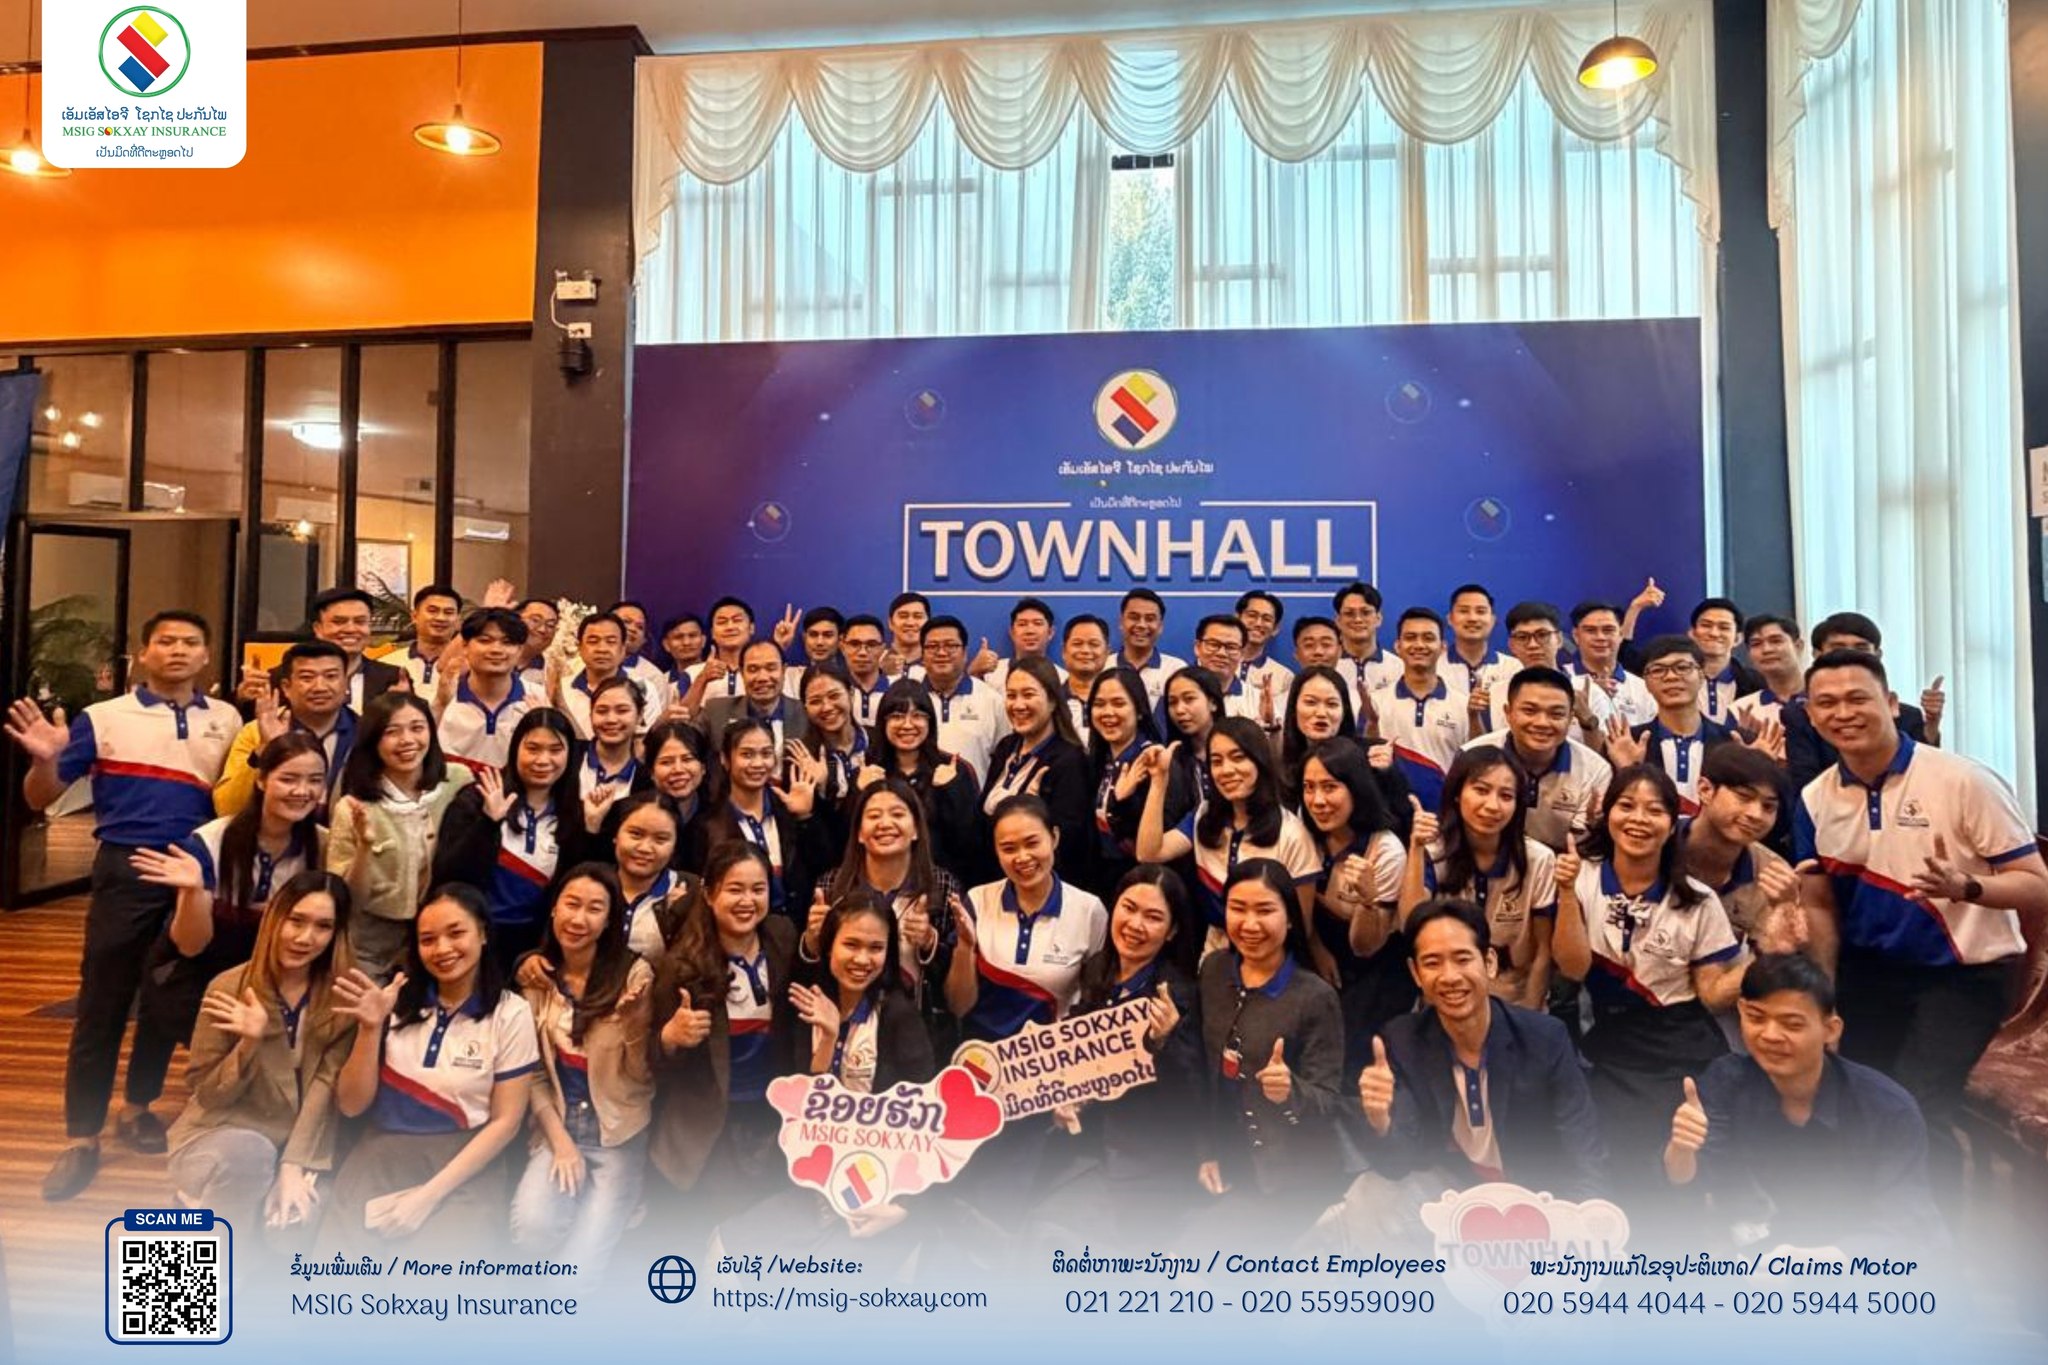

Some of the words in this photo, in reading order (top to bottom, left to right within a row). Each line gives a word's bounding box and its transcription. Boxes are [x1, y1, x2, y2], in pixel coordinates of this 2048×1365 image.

[920, 519, 1358, 578] TOWNHALL
[997, 1029, 1056, 1063] MSIG
[1058, 1001, 1150, 1043] SOKXAY
[1002, 1029, 1137, 1084] INSURANCE
[799, 1123, 850, 1145] MSIG
[853, 1125, 937, 1153] SOKXAY
